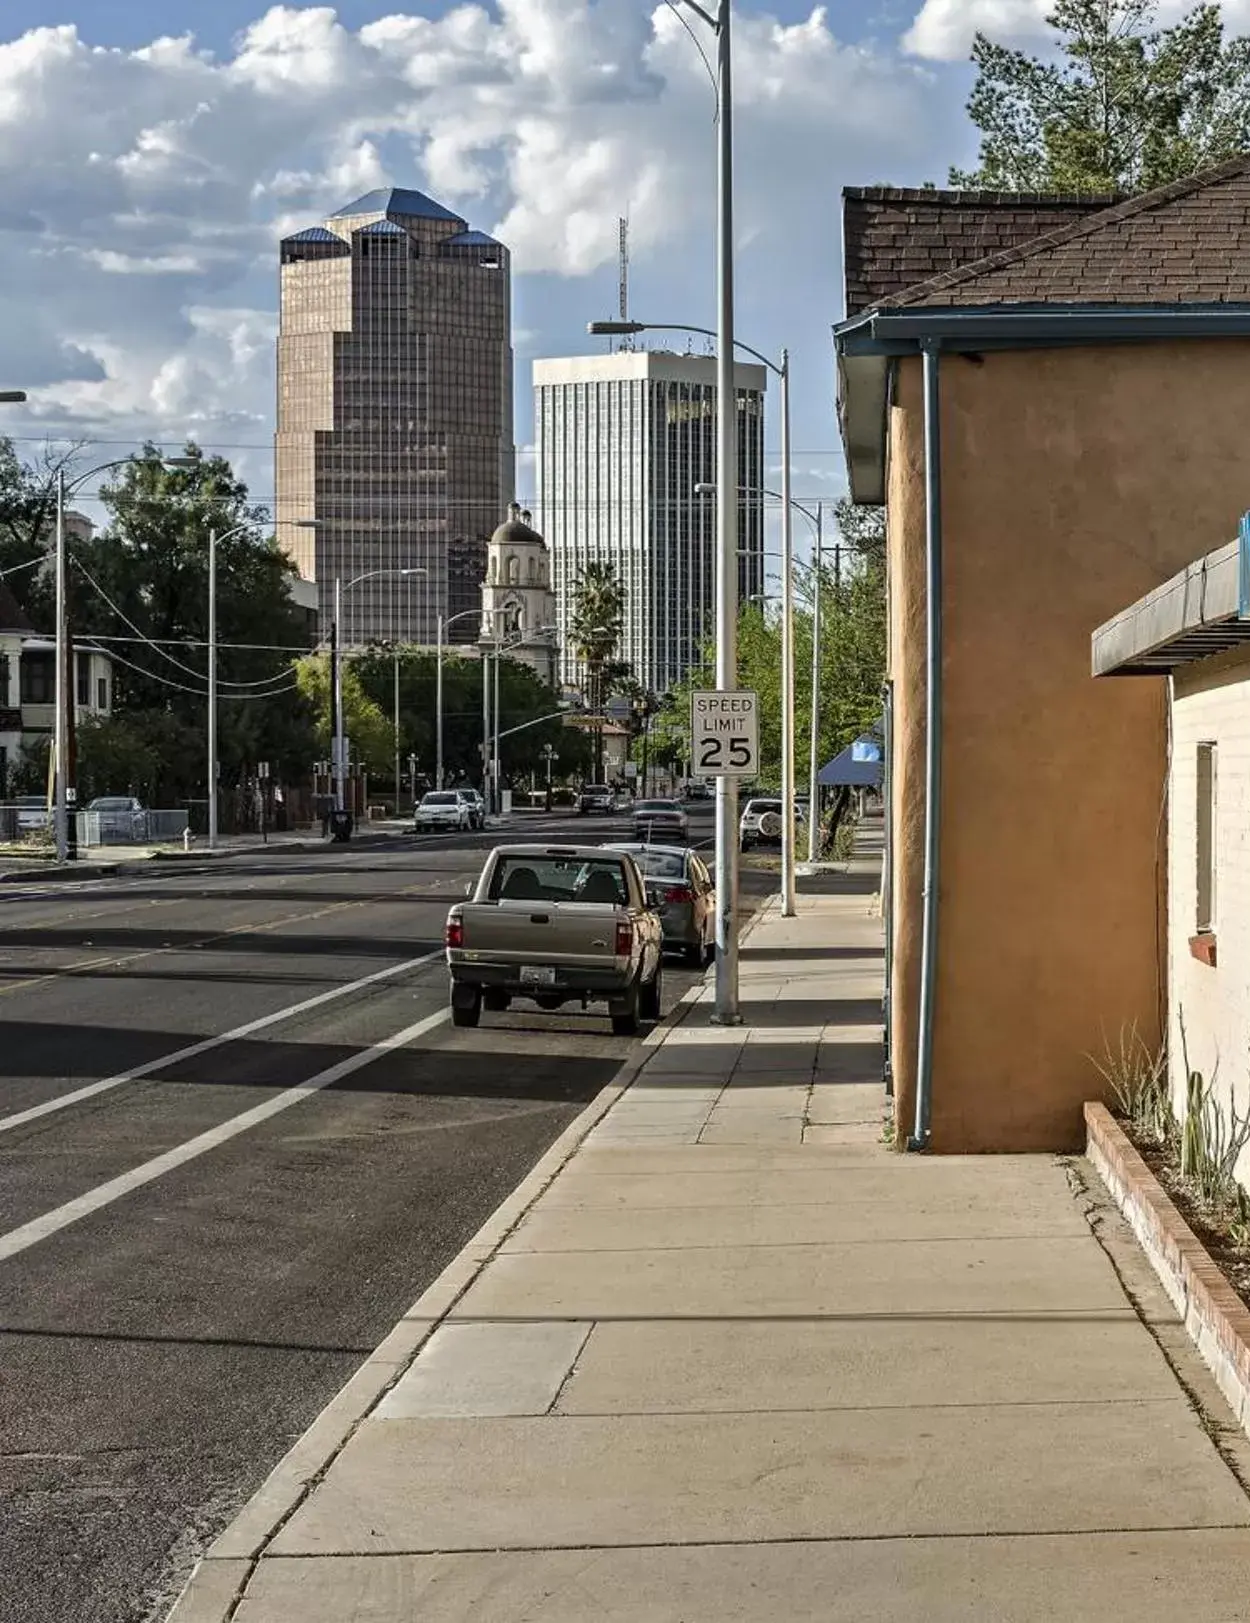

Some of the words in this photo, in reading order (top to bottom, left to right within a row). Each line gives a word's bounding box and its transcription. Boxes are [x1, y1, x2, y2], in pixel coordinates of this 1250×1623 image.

[697, 699, 753, 713] SPEED
[703, 717, 746, 732] LIMIT
[700, 737, 751, 767] 25
